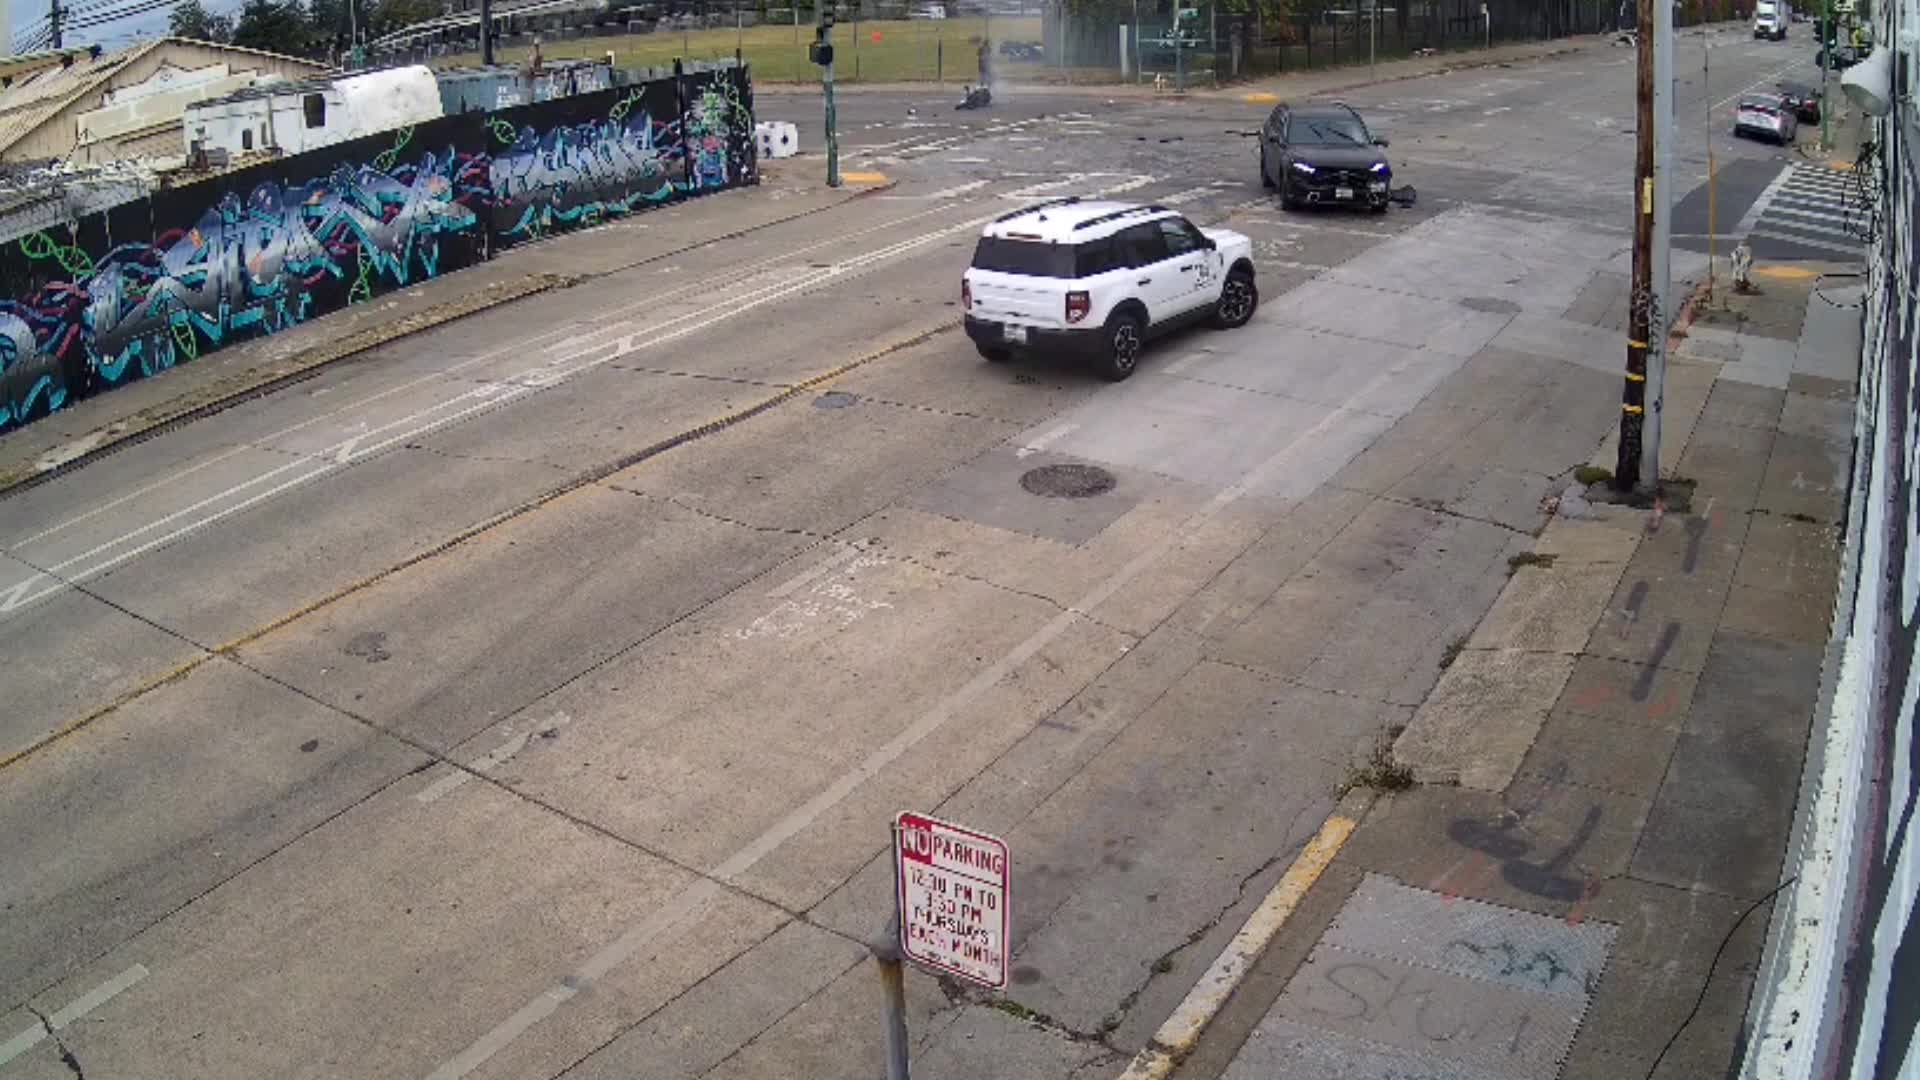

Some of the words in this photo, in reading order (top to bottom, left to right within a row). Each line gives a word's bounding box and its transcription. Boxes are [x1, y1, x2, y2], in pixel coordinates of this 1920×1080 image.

[902, 822, 930, 857] NO
[934, 836, 1003, 874] PARKING
[955, 883, 972, 902] PM
[979, 890, 996, 910] TO
[962, 904, 982, 924] PM
[910, 923, 946, 949] EACH
[952, 938, 999, 967] MONTH
[915, 906, 988, 945] THURSDAYS
